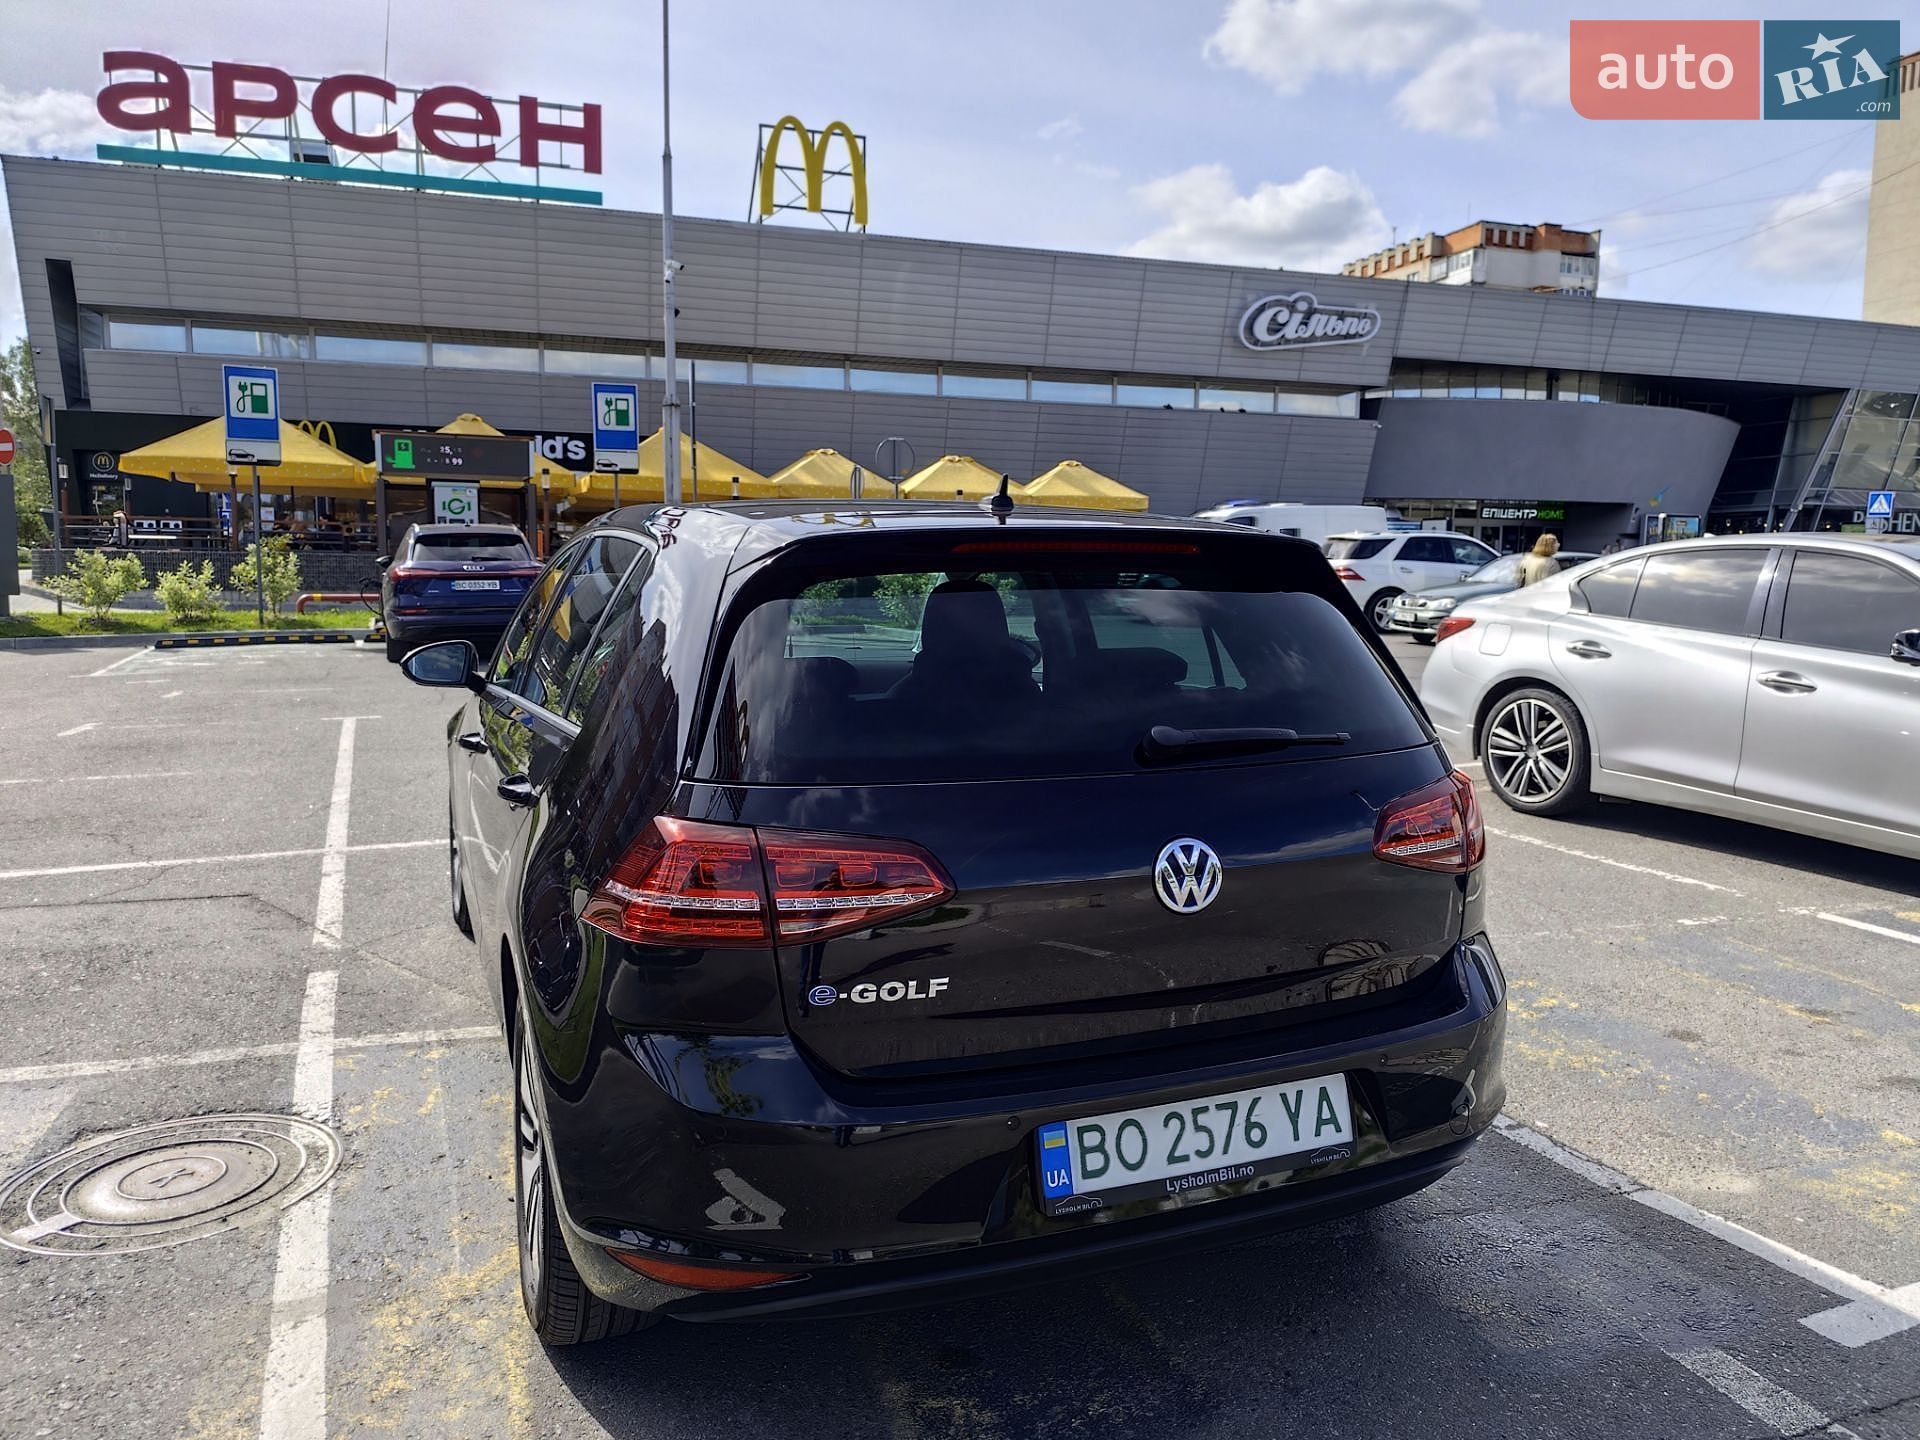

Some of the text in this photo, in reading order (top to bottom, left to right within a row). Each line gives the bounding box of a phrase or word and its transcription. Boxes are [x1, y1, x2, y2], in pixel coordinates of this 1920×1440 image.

[1253, 301, 1371, 342] Сільпо
[808, 976, 950, 1006] e-GOLF
[1076, 1086, 1343, 1181] BO 2576 YA
[1047, 1168, 1070, 1188] UA
[1166, 1165, 1255, 1194] LysholmBil.no
